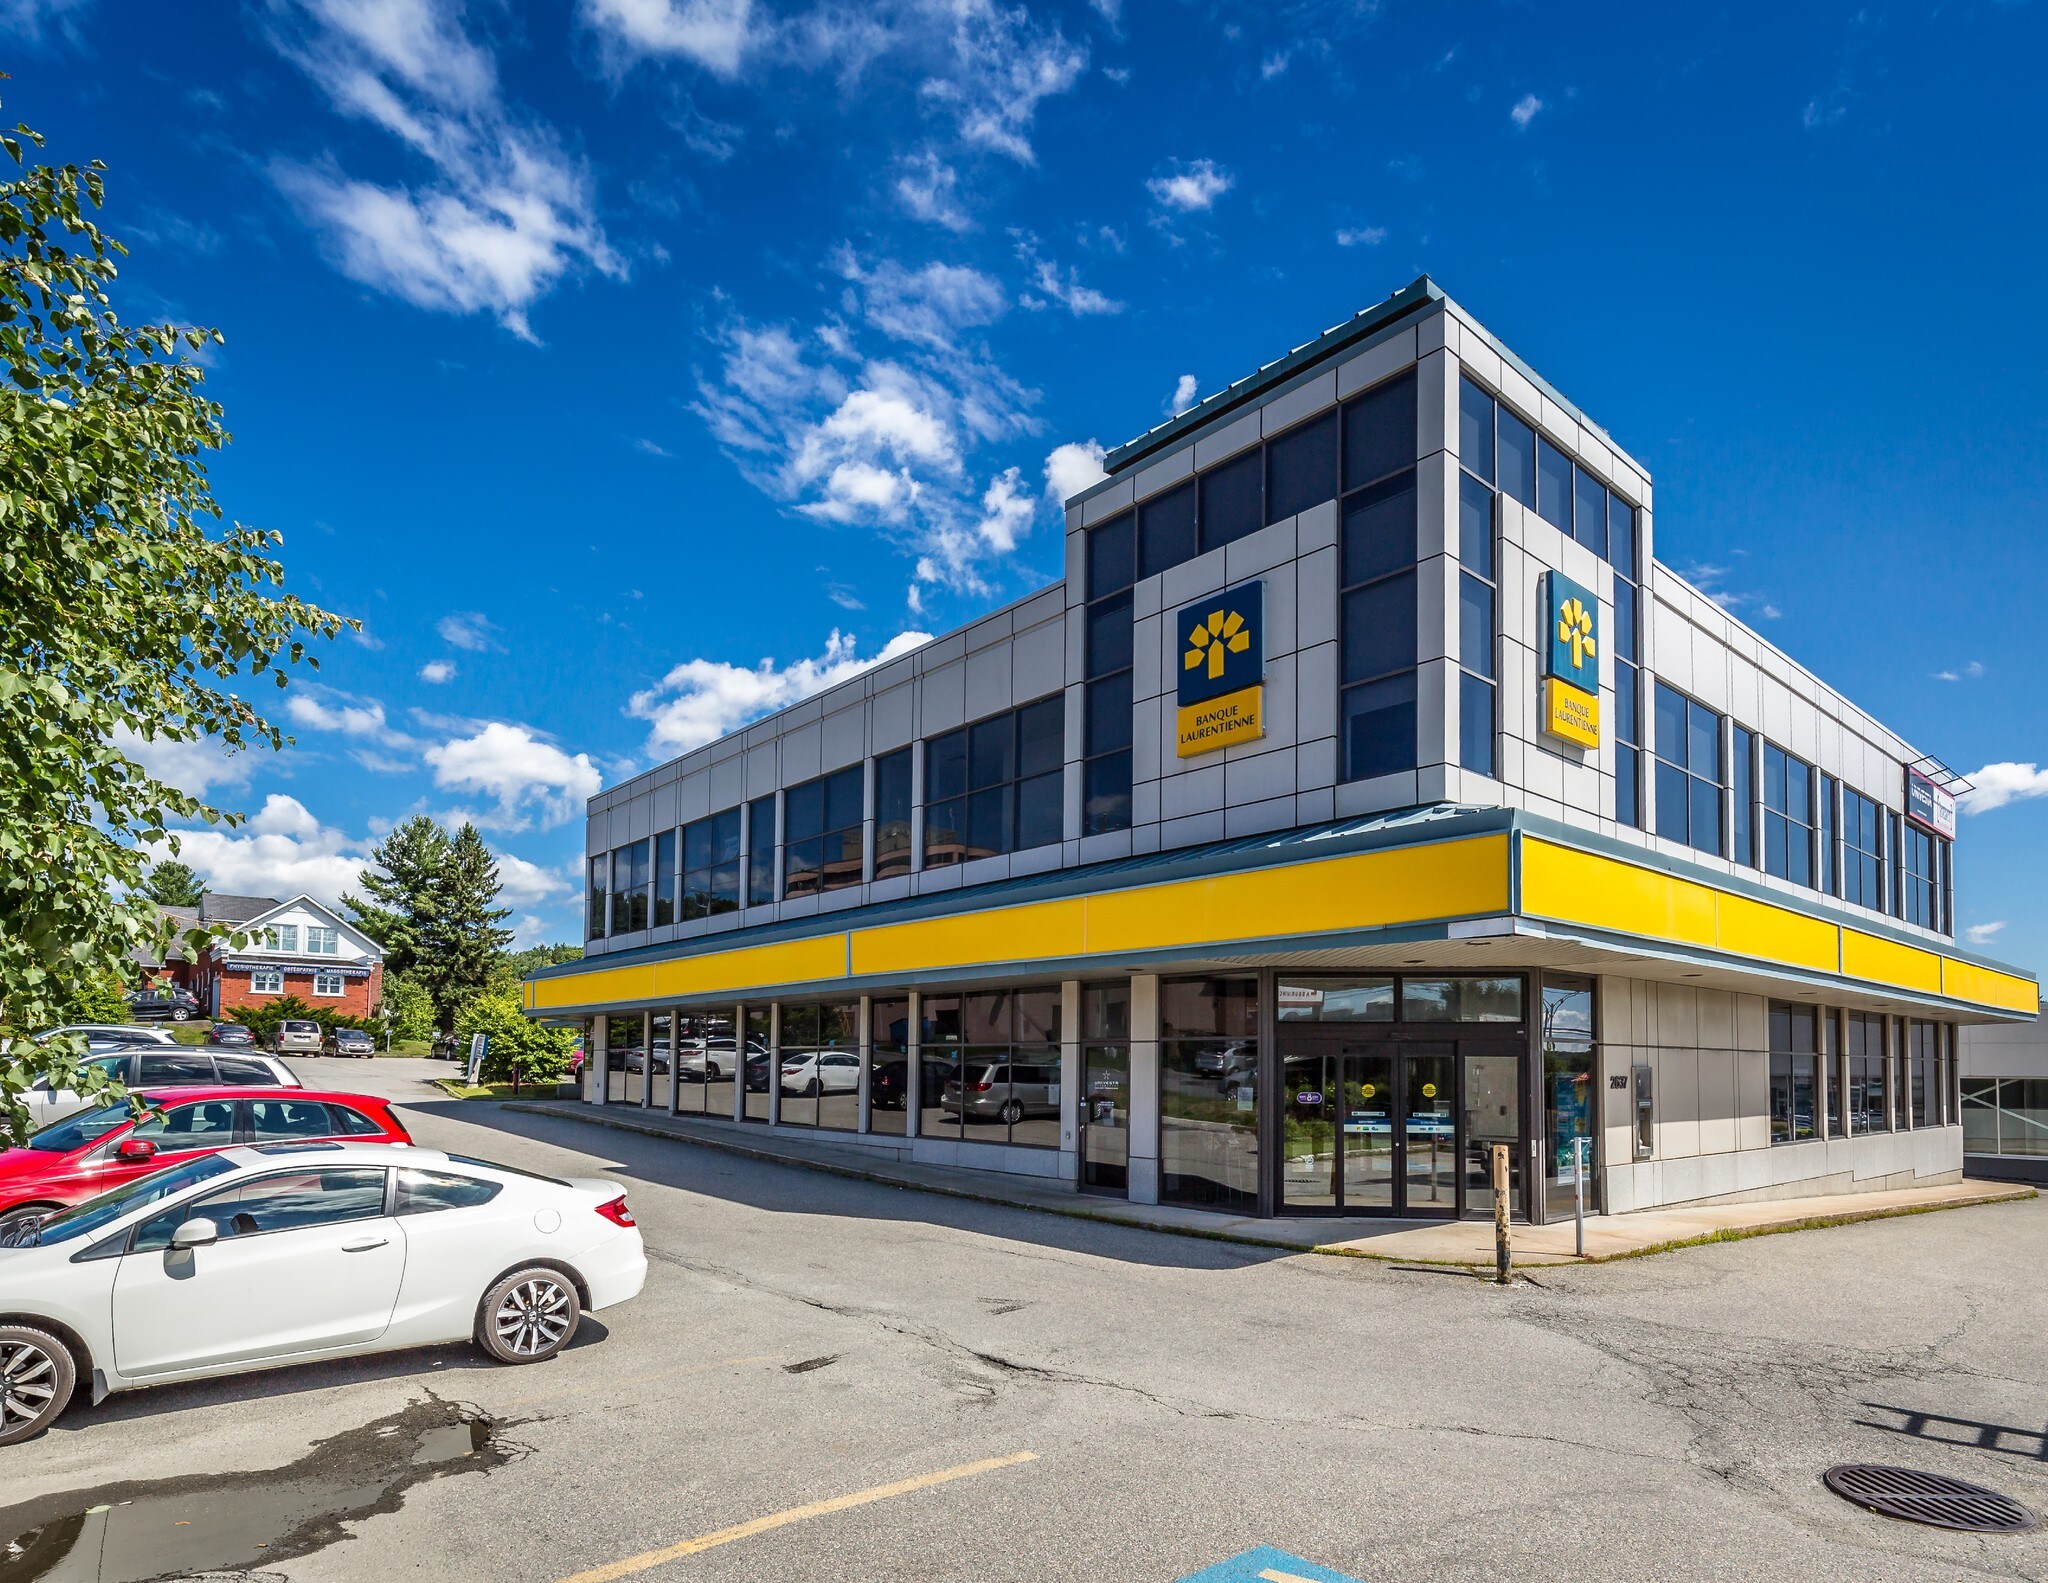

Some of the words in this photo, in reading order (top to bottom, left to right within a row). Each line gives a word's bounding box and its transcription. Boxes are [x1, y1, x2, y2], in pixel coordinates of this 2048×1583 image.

[1196, 705, 1238, 726] BANQUE
[1565, 698, 1589, 718] BANQUE
[1181, 714, 1255, 744] LAURENTIENNE
[1555, 707, 1597, 735] LAURENTIENNE
